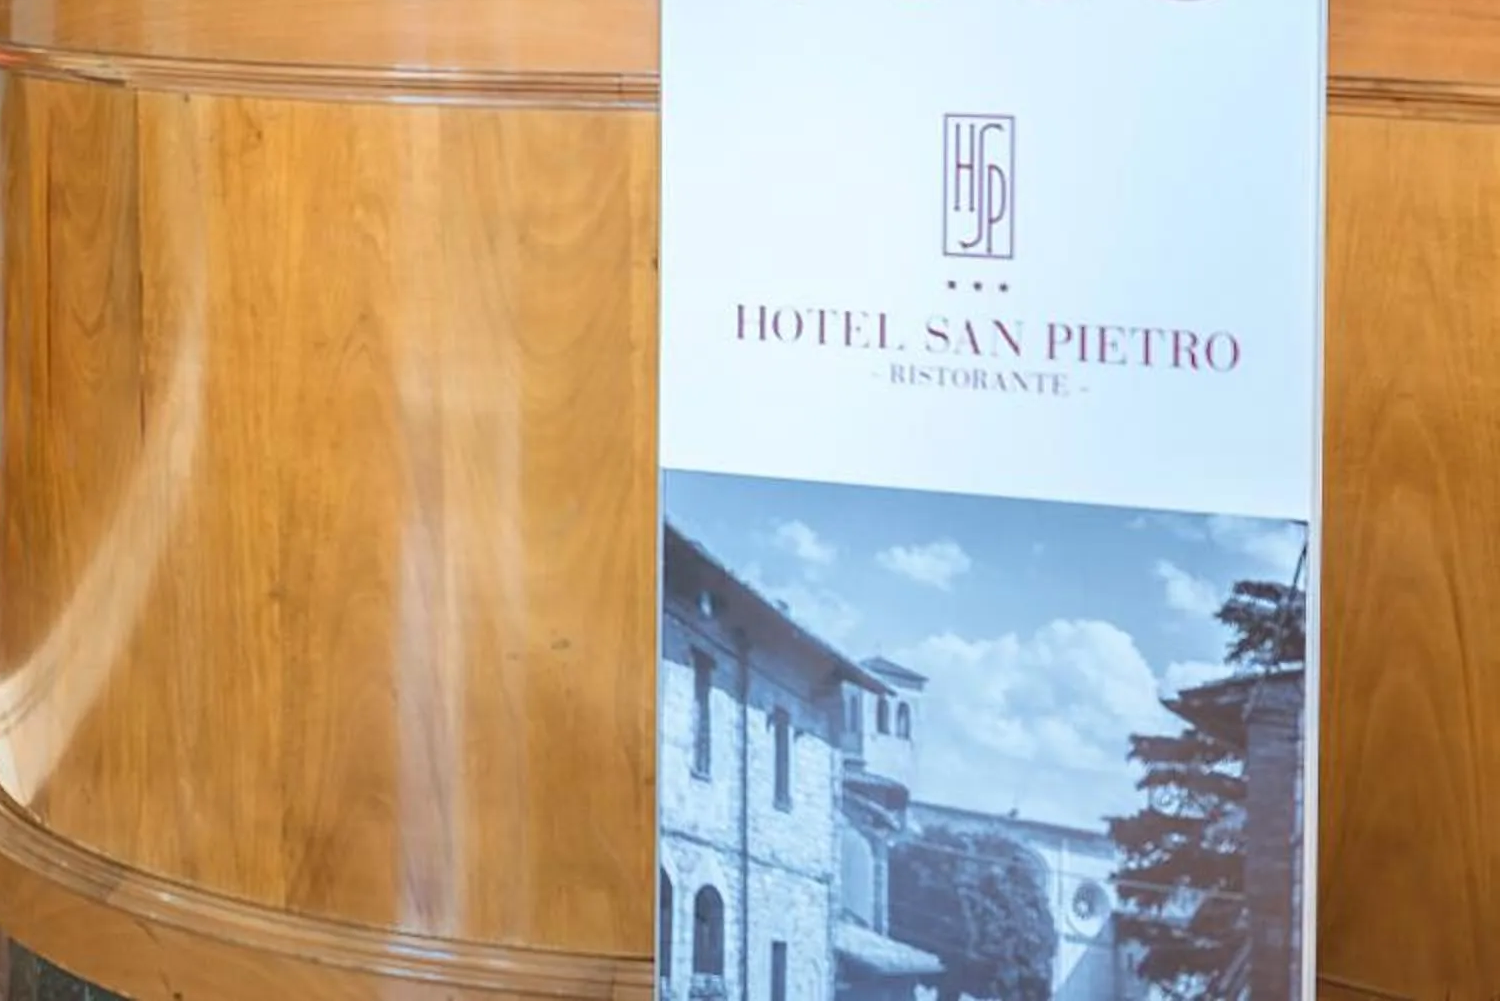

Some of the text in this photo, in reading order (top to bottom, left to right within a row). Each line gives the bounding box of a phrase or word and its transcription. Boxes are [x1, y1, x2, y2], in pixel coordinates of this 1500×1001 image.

[735, 303, 1242, 373] HOTEL SAN PIETRO
